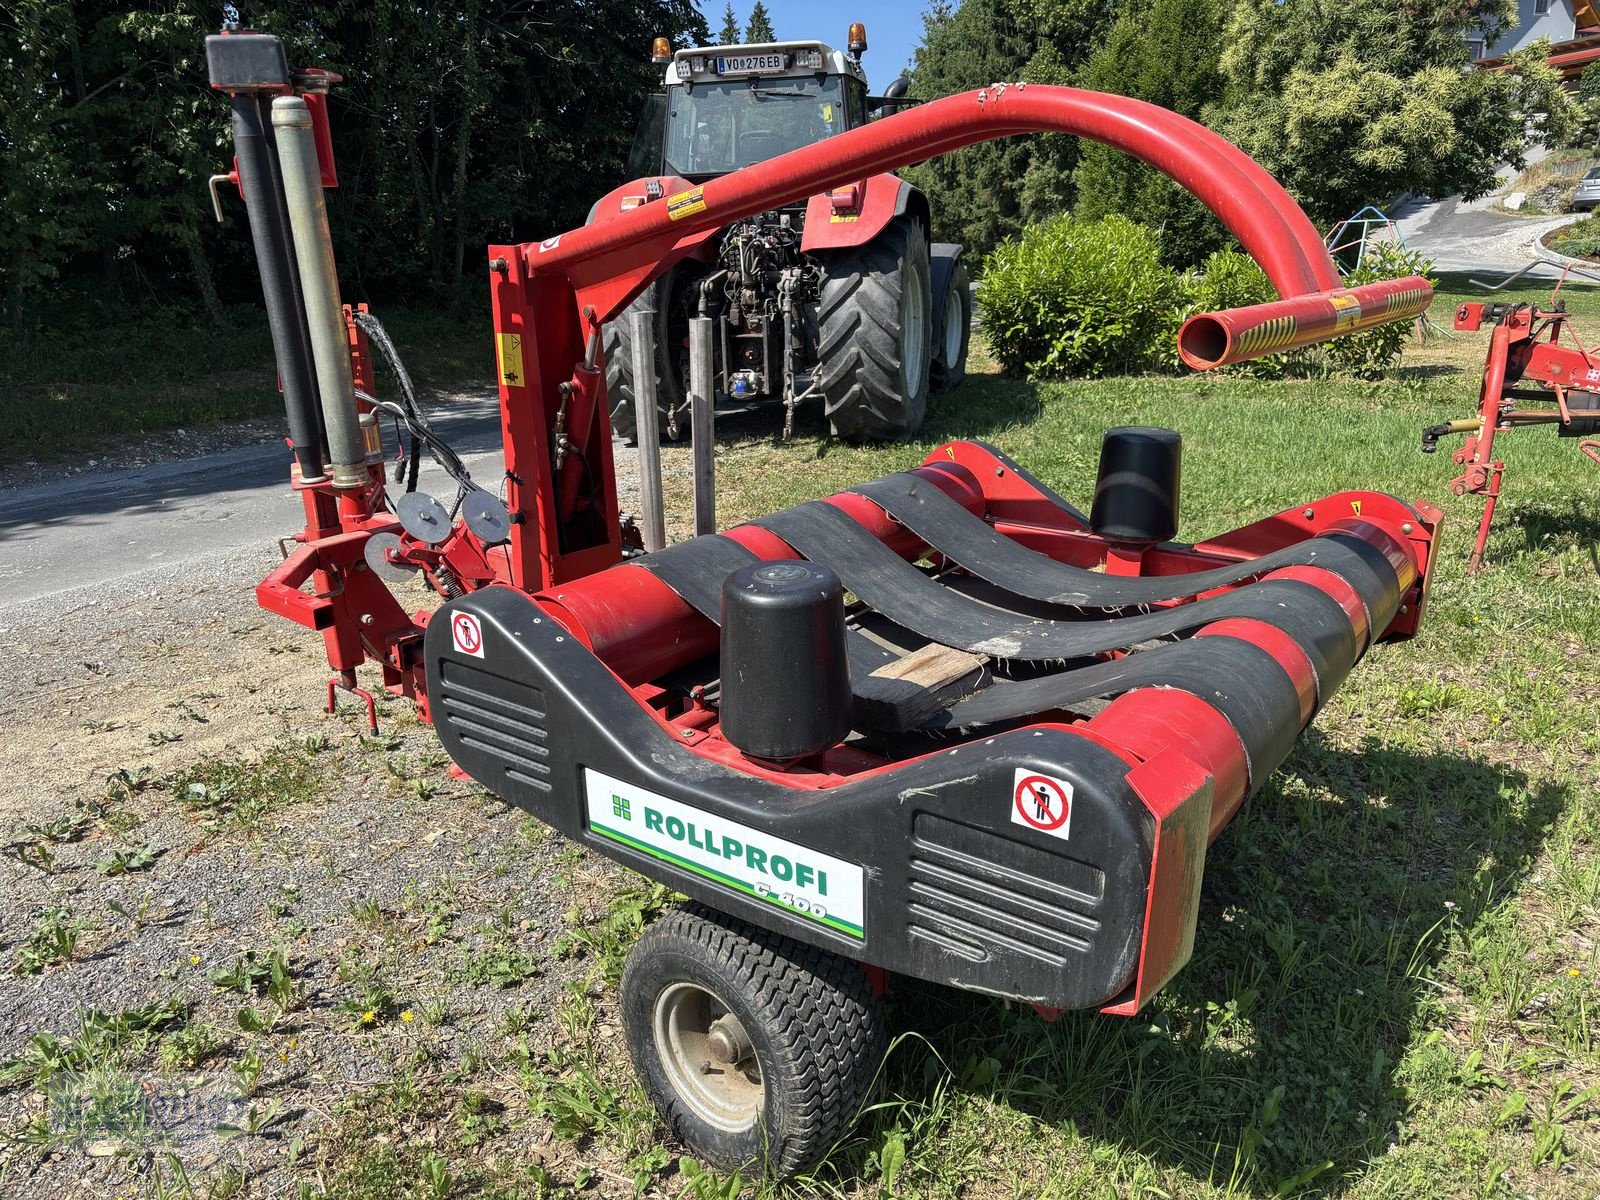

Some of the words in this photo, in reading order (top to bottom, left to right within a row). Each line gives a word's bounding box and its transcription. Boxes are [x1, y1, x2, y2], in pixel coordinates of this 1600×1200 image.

[726, 58, 739, 70] VO
[644, 806, 828, 896] ROLLPROFI
[777, 891, 827, 919] 400
